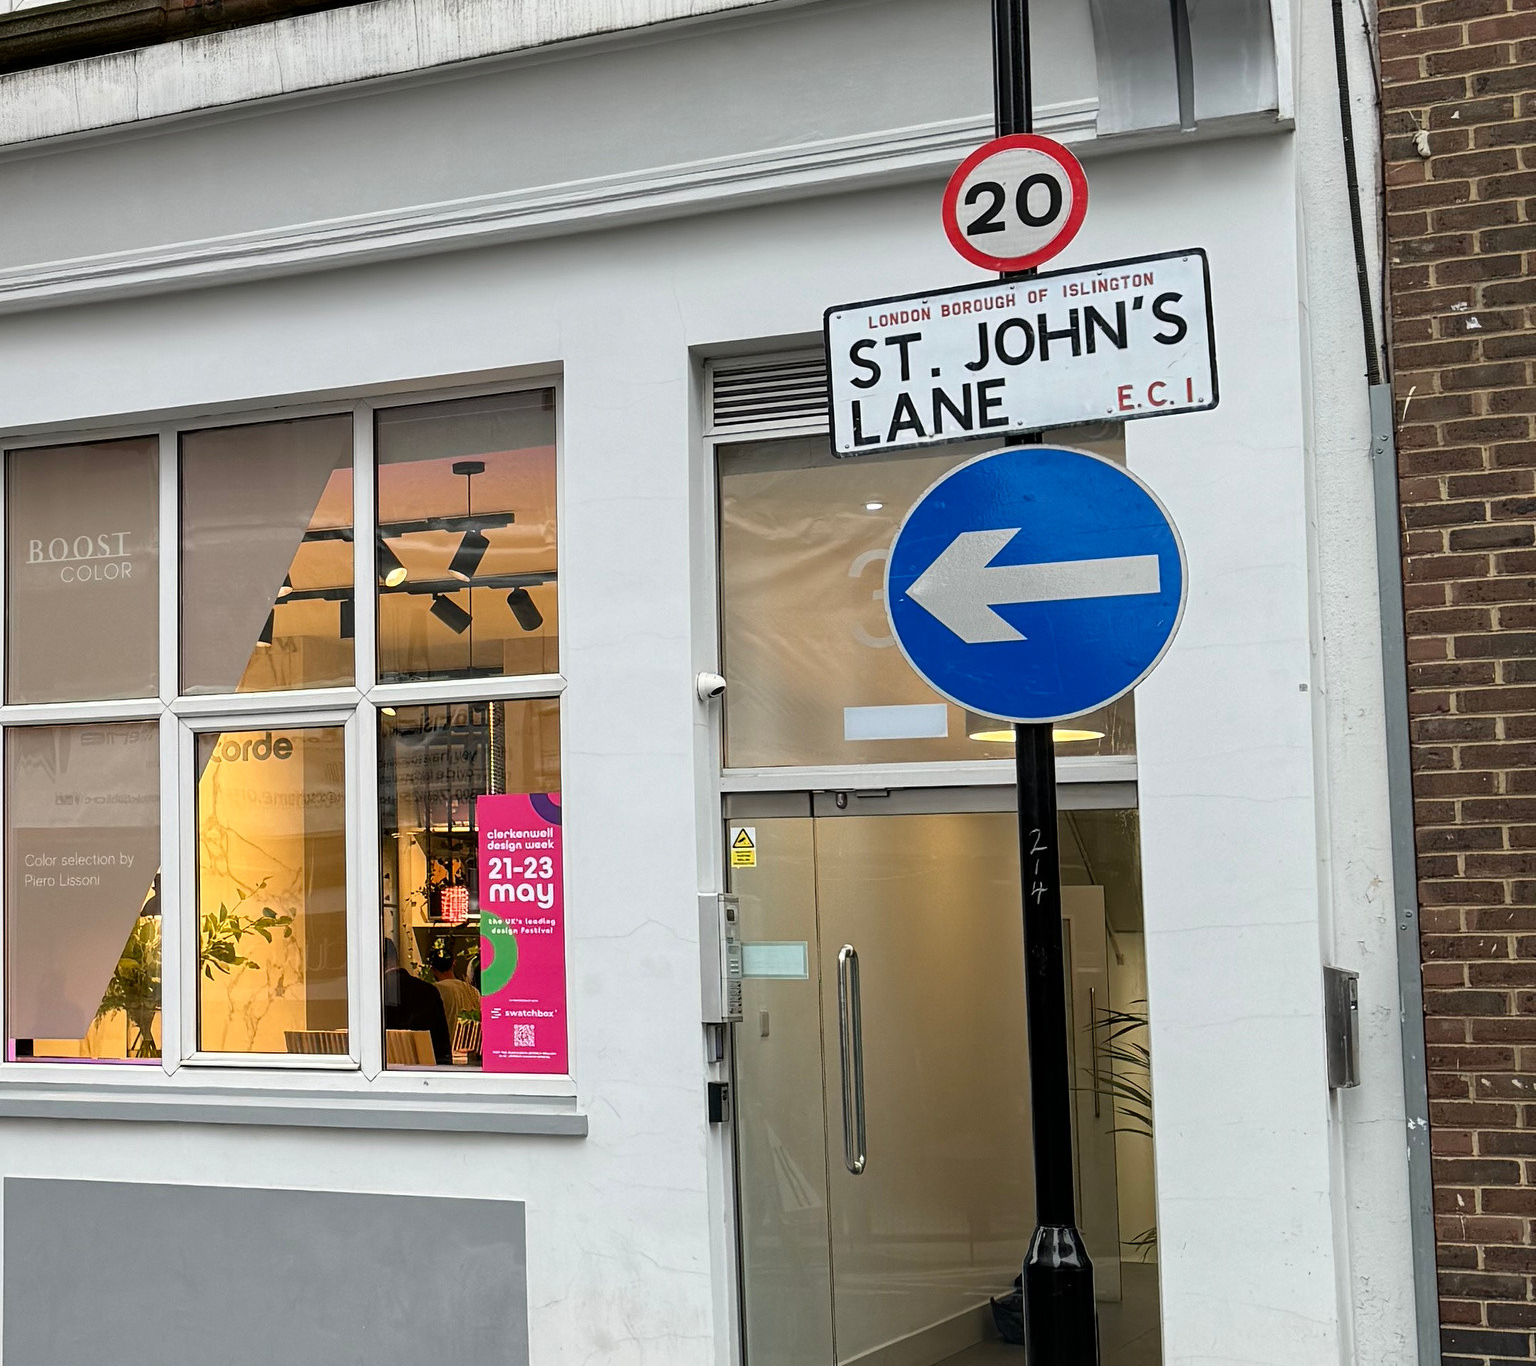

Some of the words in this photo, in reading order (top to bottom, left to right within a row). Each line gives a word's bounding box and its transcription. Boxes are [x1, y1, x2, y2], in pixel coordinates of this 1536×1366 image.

[964, 173, 1063, 235] 20
[868, 306, 931, 329] LONDON
[941, 293, 1016, 318] BOROUGH
[1027, 288, 1048, 304] OF
[1063, 271, 1155, 298] ISLINGTON
[849, 331, 941, 389] ST.
[964, 291, 1188, 372] JOHN'S
[851, 377, 1009, 447] LANE
[26, 531, 132, 564] BOOST
[60, 562, 132, 583] COLOR
[487, 827, 554, 839] clerkenwell
[487, 840, 523, 852] design
[525, 839, 554, 849] week
[24, 853, 58, 867] Color
[61, 852, 116, 866] selection
[119, 851, 135, 868] by
[488, 856, 554, 880] 21-23
[24, 874, 56, 887] Piero
[59, 873, 100, 887] Lissoni
[489, 883, 554, 909] may
[491, 926, 519, 936] design
[525, 917, 556, 927] leading
[505, 1009, 554, 1018] swatchbox
